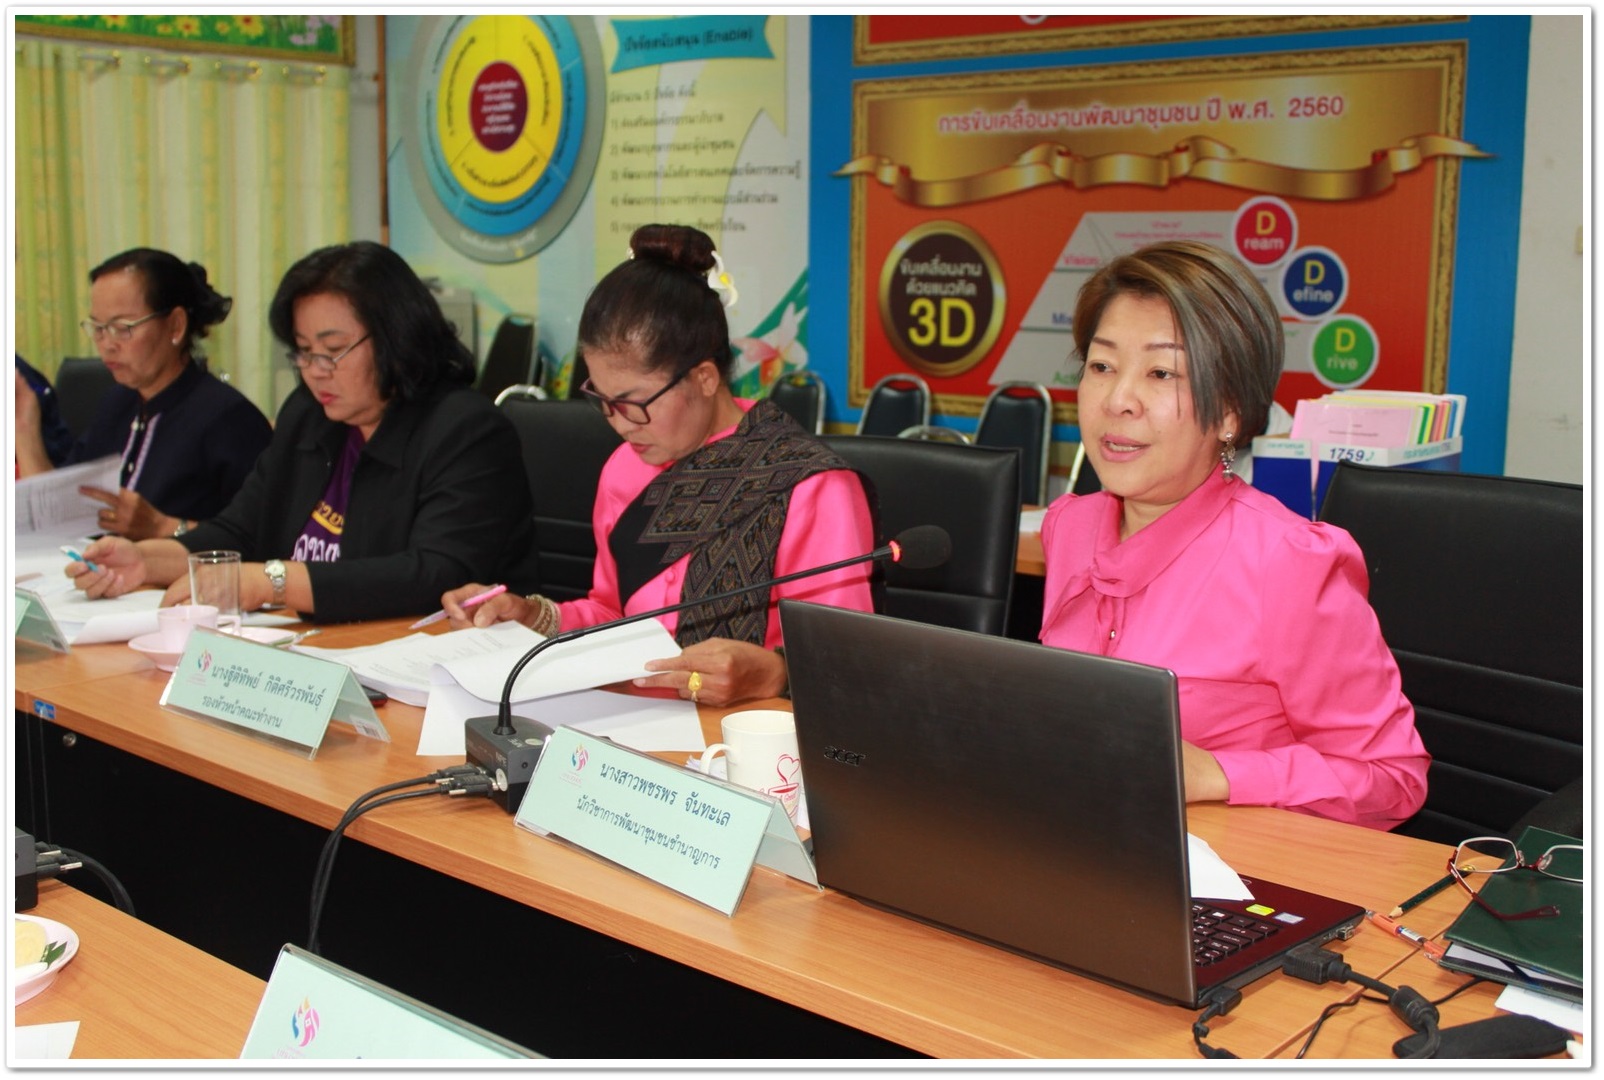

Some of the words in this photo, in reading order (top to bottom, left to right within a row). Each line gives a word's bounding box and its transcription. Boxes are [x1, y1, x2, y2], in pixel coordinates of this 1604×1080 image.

[702, 27, 755, 45] (Enable)
[938, 101, 1200, 131] การขับเคลื่อนงานพัฒนาชุมชน
[1206, 97, 1222, 121] ปี
[1228, 100, 1275, 119] พ.ศ.
[1288, 96, 1344, 118] 2560
[1256, 211, 1277, 235] D
[1244, 237, 1285, 251] ream
[901, 254, 983, 277] ขับเคลื่อนงาน
[1304, 260, 1326, 285] D
[906, 278, 977, 296] ด้วยแนวคิด
[1292, 287, 1335, 304] efine
[908, 297, 976, 346] 3D
[1335, 327, 1357, 353] D
[1326, 353, 1359, 371] rive
[823, 745, 867, 767] acer
[600, 762, 678, 806] นางสาวพชรพร
[684, 791, 732, 828] จันทะเล
[576, 795, 722, 870] นักวิชาการพัฒนาชุมชนชำนาญการ
